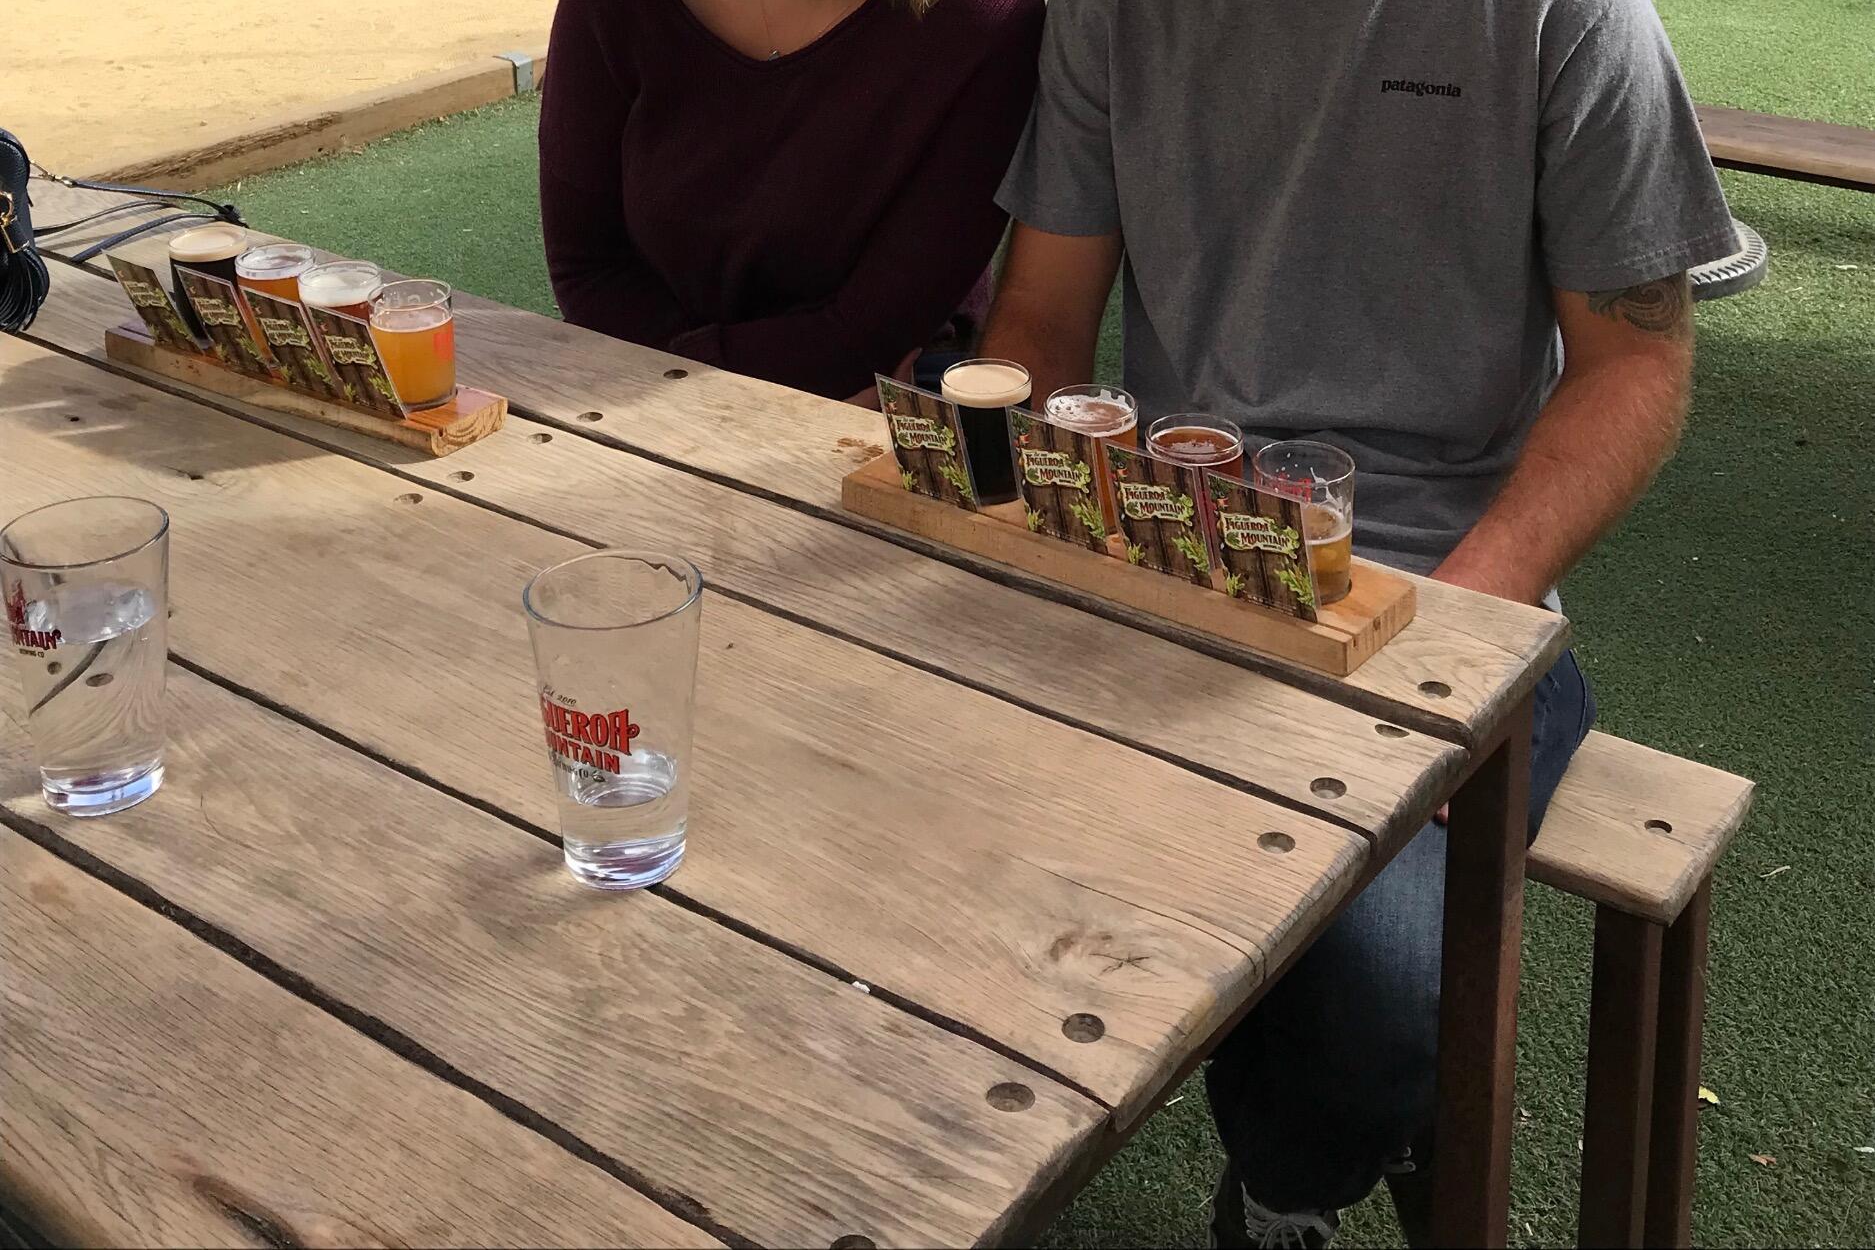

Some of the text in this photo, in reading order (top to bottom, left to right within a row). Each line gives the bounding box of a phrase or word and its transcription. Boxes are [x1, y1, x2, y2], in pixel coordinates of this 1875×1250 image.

[1381, 79, 1462, 97] patagonia
[910, 432, 948, 445] MOUNTAIN
[1026, 454, 1064, 467] FIGUEROA
[1040, 469, 1081, 481] MOUNTAIN
[1124, 487, 1166, 501] FIGUEROA
[1139, 501, 1185, 515] MOUNTAIN
[1224, 517, 1269, 532] FIGUEROA
[1240, 532, 1289, 547] MOUNTAIN
